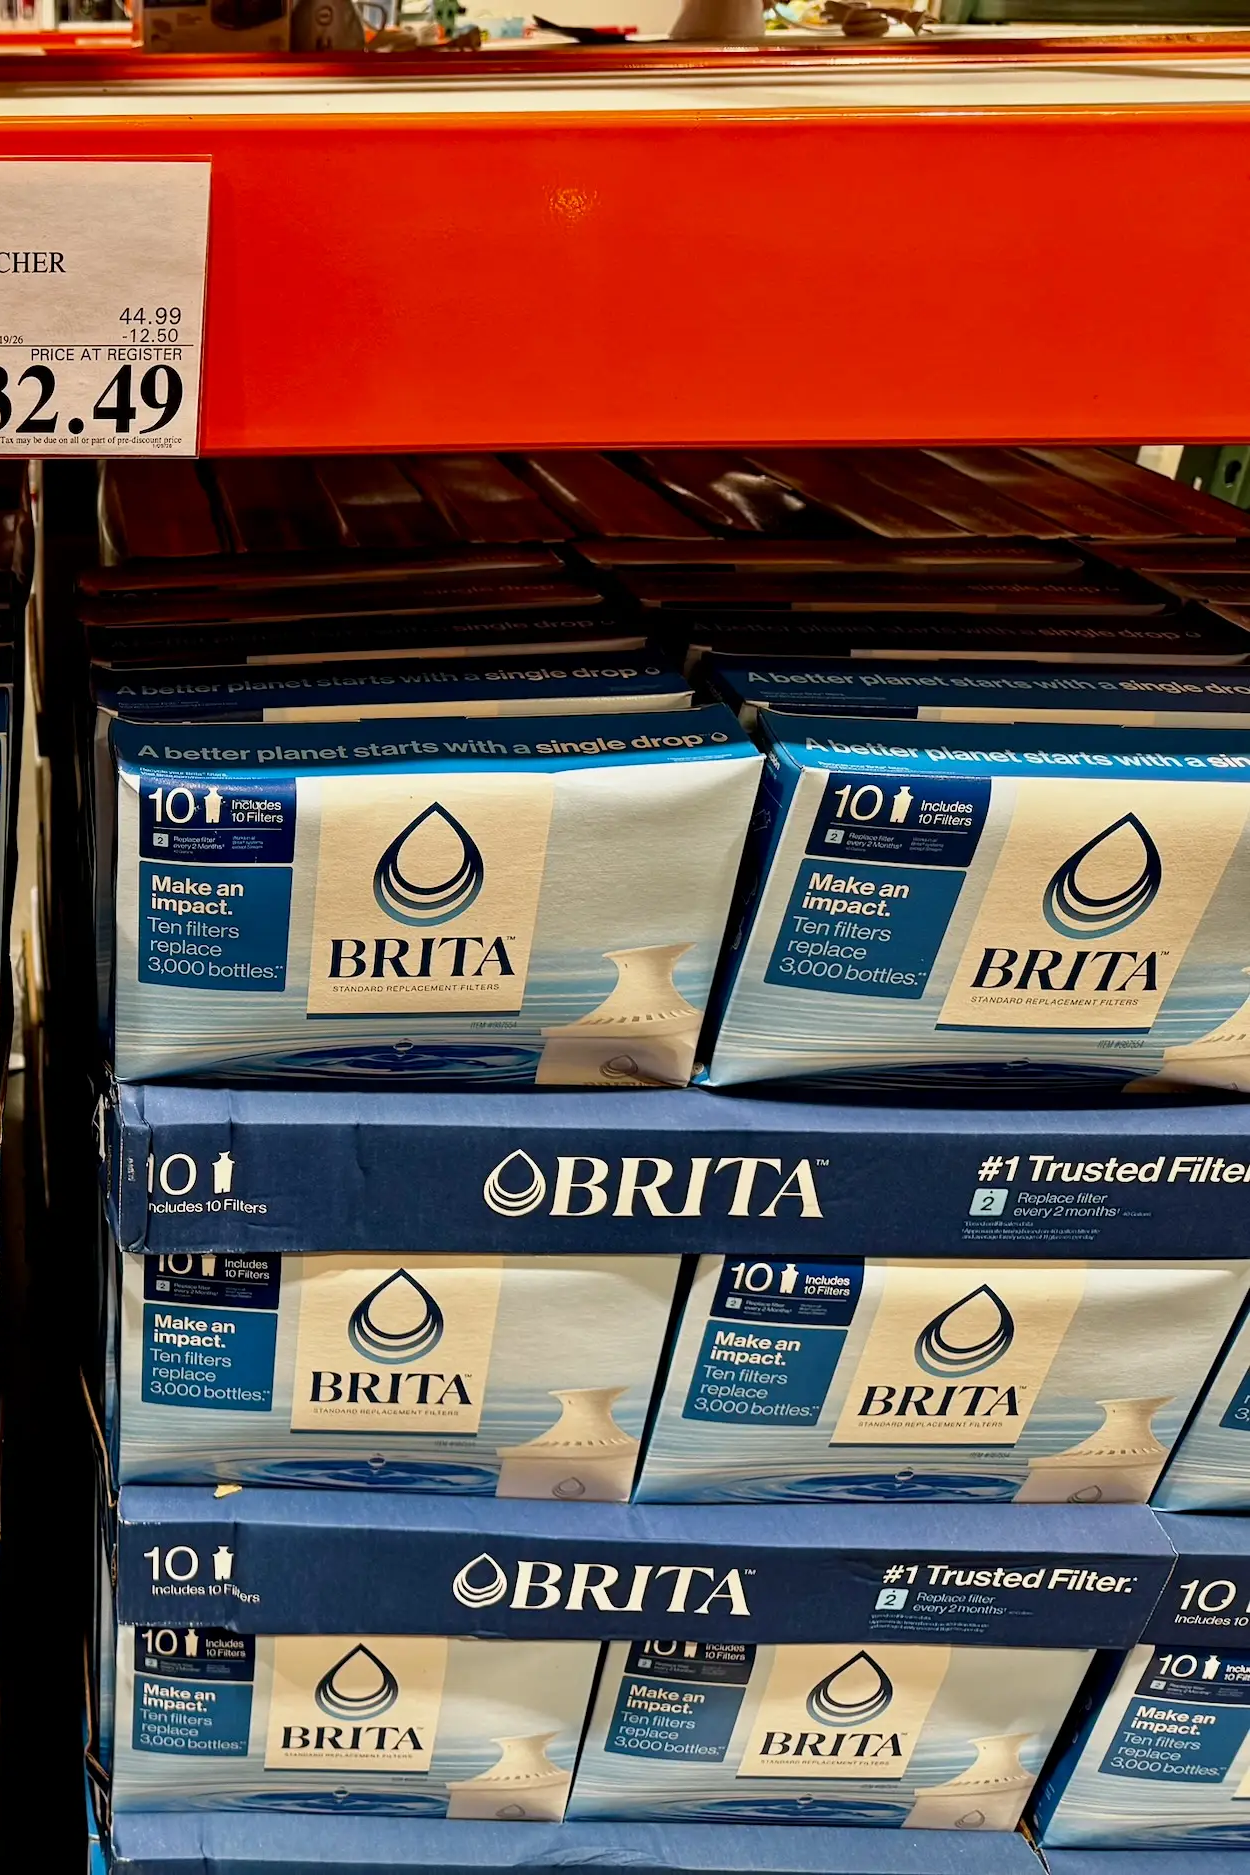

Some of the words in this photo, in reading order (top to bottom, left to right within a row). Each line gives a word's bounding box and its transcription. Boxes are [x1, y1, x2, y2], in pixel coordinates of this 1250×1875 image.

[119, 307, 182, 325] 44.99
[122, 329, 178, 343] -12.50
[31, 348, 74, 361] PRICE
[80, 348, 102, 361] AT
[107, 348, 183, 361] REGISTER
[0, 436, 14, 445] Tax
[16, 437, 31, 446] may
[33, 436, 42, 445] be
[43, 436, 57, 445] due
[58, 437, 69, 445] on
[70, 436, 80, 445] all
[81, 437, 90, 445] or
[91, 436, 105, 446] part
[107, 436, 116, 445] of
[117, 436, 162, 446] pre-discount
[163, 436, 182, 446] price
[115, 685, 137, 696] A
[140, 682, 222, 697] better
[226, 678, 313, 695] planet
[317, 674, 396, 688] starts
[399, 671, 459, 685] with
[463, 671, 481, 682] a
[484, 668, 567, 683] single
[571, 665, 637, 680] drop
[137, 744, 159, 759] A
[164, 746, 251, 761] better
[257, 745, 347, 763] planet
[353, 740, 440, 758] starts
[442, 739, 508, 754] with
[512, 742, 531, 755] a
[535, 736, 627, 755] single
[630, 733, 703, 750] drop
[805, 737, 829, 752] A
[828, 739, 919, 759] better
[924, 745, 1022, 763] planet
[1023, 749, 1108, 767] starts
[1113, 752, 1184, 768] with
[1183, 755, 1207, 768] a
[834, 784, 884, 821] 10
[920, 800, 974, 814] Includes
[918, 813, 933, 824] 10
[933, 814, 973, 827] Filters
[151, 874, 213, 897] Make
[216, 882, 244, 897] an
[151, 893, 233, 916] impact.
[146, 916, 183, 935] Ten
[185, 921, 240, 940] filters
[150, 939, 223, 958] replace
[147, 956, 205, 976] 3,000
[970, 995, 1024, 1005] STANDARD
[1025, 997, 1098, 1007] REPLACEMENT
[1099, 998, 1139, 1007] FILTERS
[977, 1155, 1021, 1183] #1
[1027, 1154, 1166, 1184] Trusted
[714, 1330, 773, 1351] Make
[774, 1339, 802, 1352] an
[709, 1345, 787, 1367] impact.
[703, 1364, 736, 1381] Ten
[738, 1368, 788, 1385] filters
[699, 1382, 769, 1400] replace
[693, 1396, 749, 1414] 3,000
[881, 1564, 919, 1585] #1
[926, 1564, 1047, 1590] Trusted
[1136, 1705, 1189, 1723] Make
[1191, 1712, 1217, 1725] an
[1130, 1717, 1201, 1736] impact.
